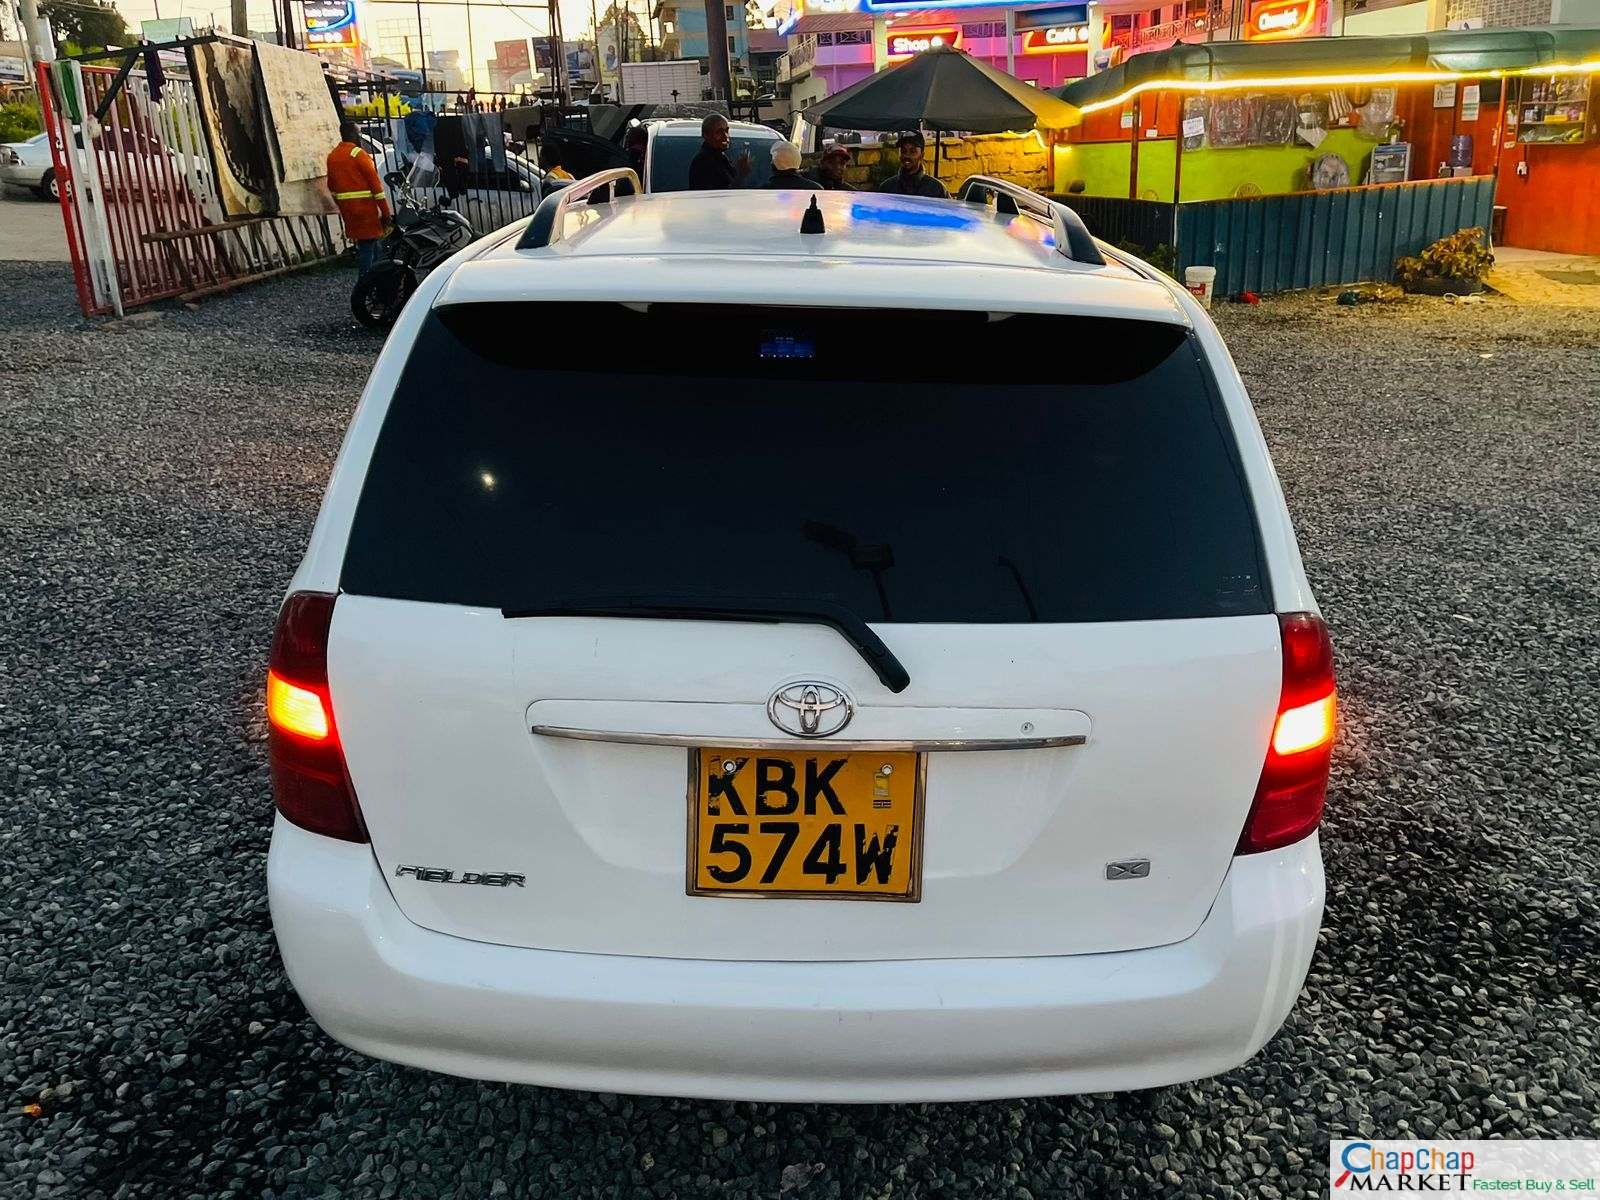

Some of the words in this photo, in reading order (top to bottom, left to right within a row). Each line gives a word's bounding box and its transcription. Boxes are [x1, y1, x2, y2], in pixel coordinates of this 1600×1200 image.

[893, 37, 930, 52] Shop
[707, 755, 849, 817] KBK
[707, 822, 899, 886] 574W
[395, 864, 526, 888] FIELDER
